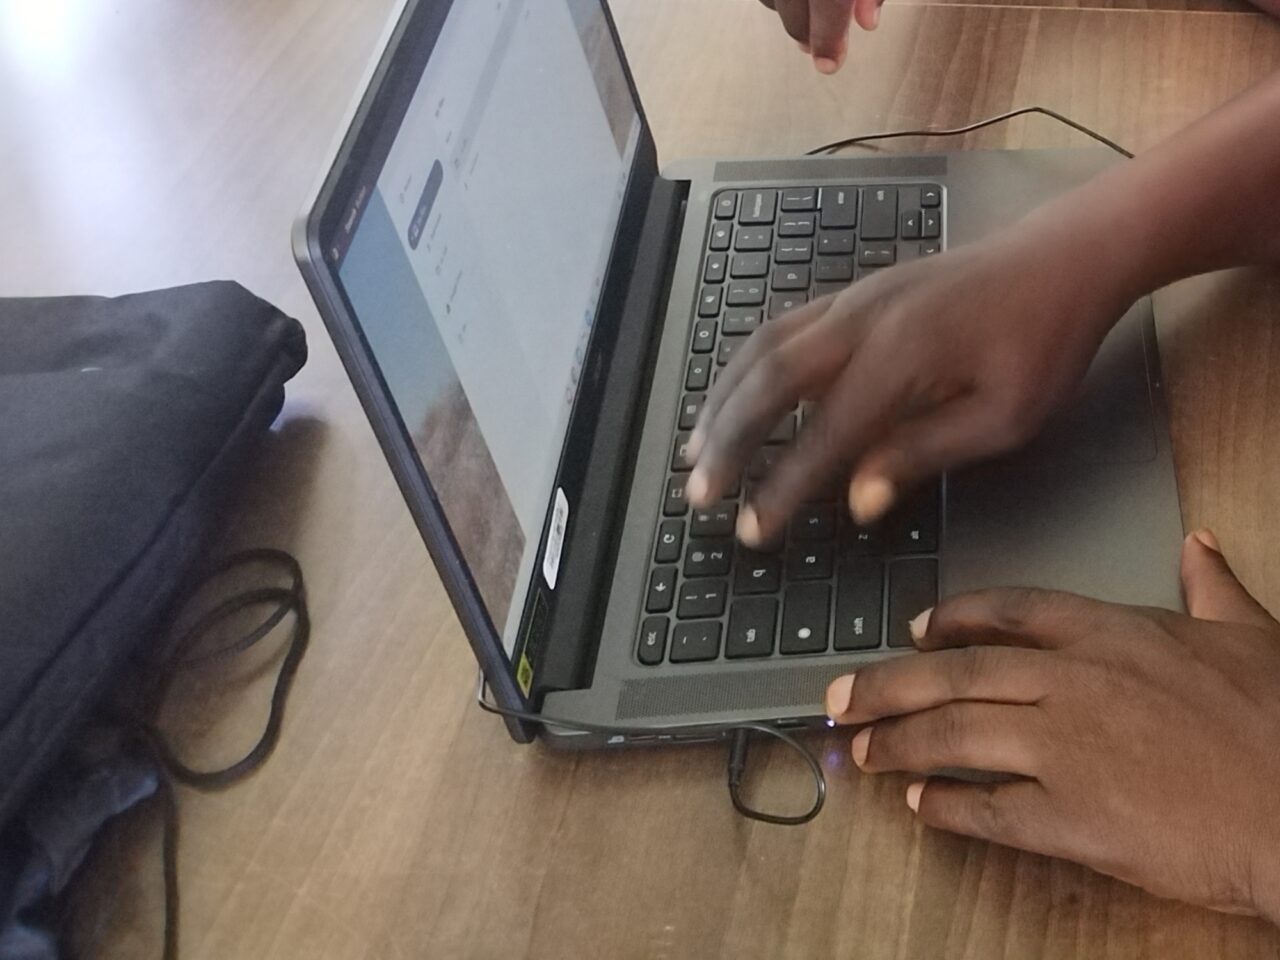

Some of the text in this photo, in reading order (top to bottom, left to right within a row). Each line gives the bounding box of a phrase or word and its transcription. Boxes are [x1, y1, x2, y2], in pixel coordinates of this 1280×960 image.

[711, 552, 722, 560] 2
[854, 617, 864, 634] shift
[647, 632, 657, 645] esc
[746, 629, 756, 642] tab
